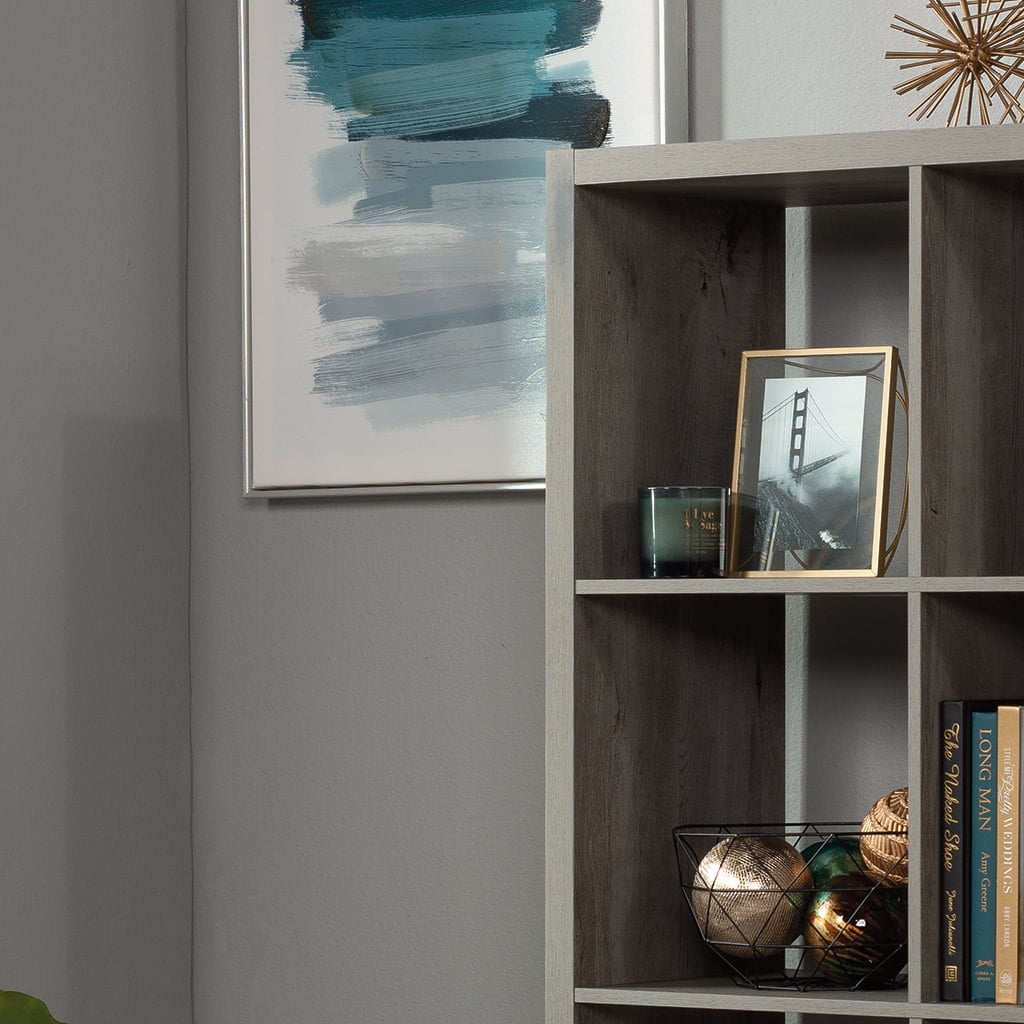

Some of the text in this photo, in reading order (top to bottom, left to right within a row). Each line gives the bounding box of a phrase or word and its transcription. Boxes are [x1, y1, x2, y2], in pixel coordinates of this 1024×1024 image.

[978, 728, 992, 831] LONG MAN
[1003, 747, 1012, 765] STYLE
[943, 722, 961, 872] The Naked Shoe
[979, 851, 991, 913] Amy Greene
[1003, 817, 1014, 894] WEDDINGS
